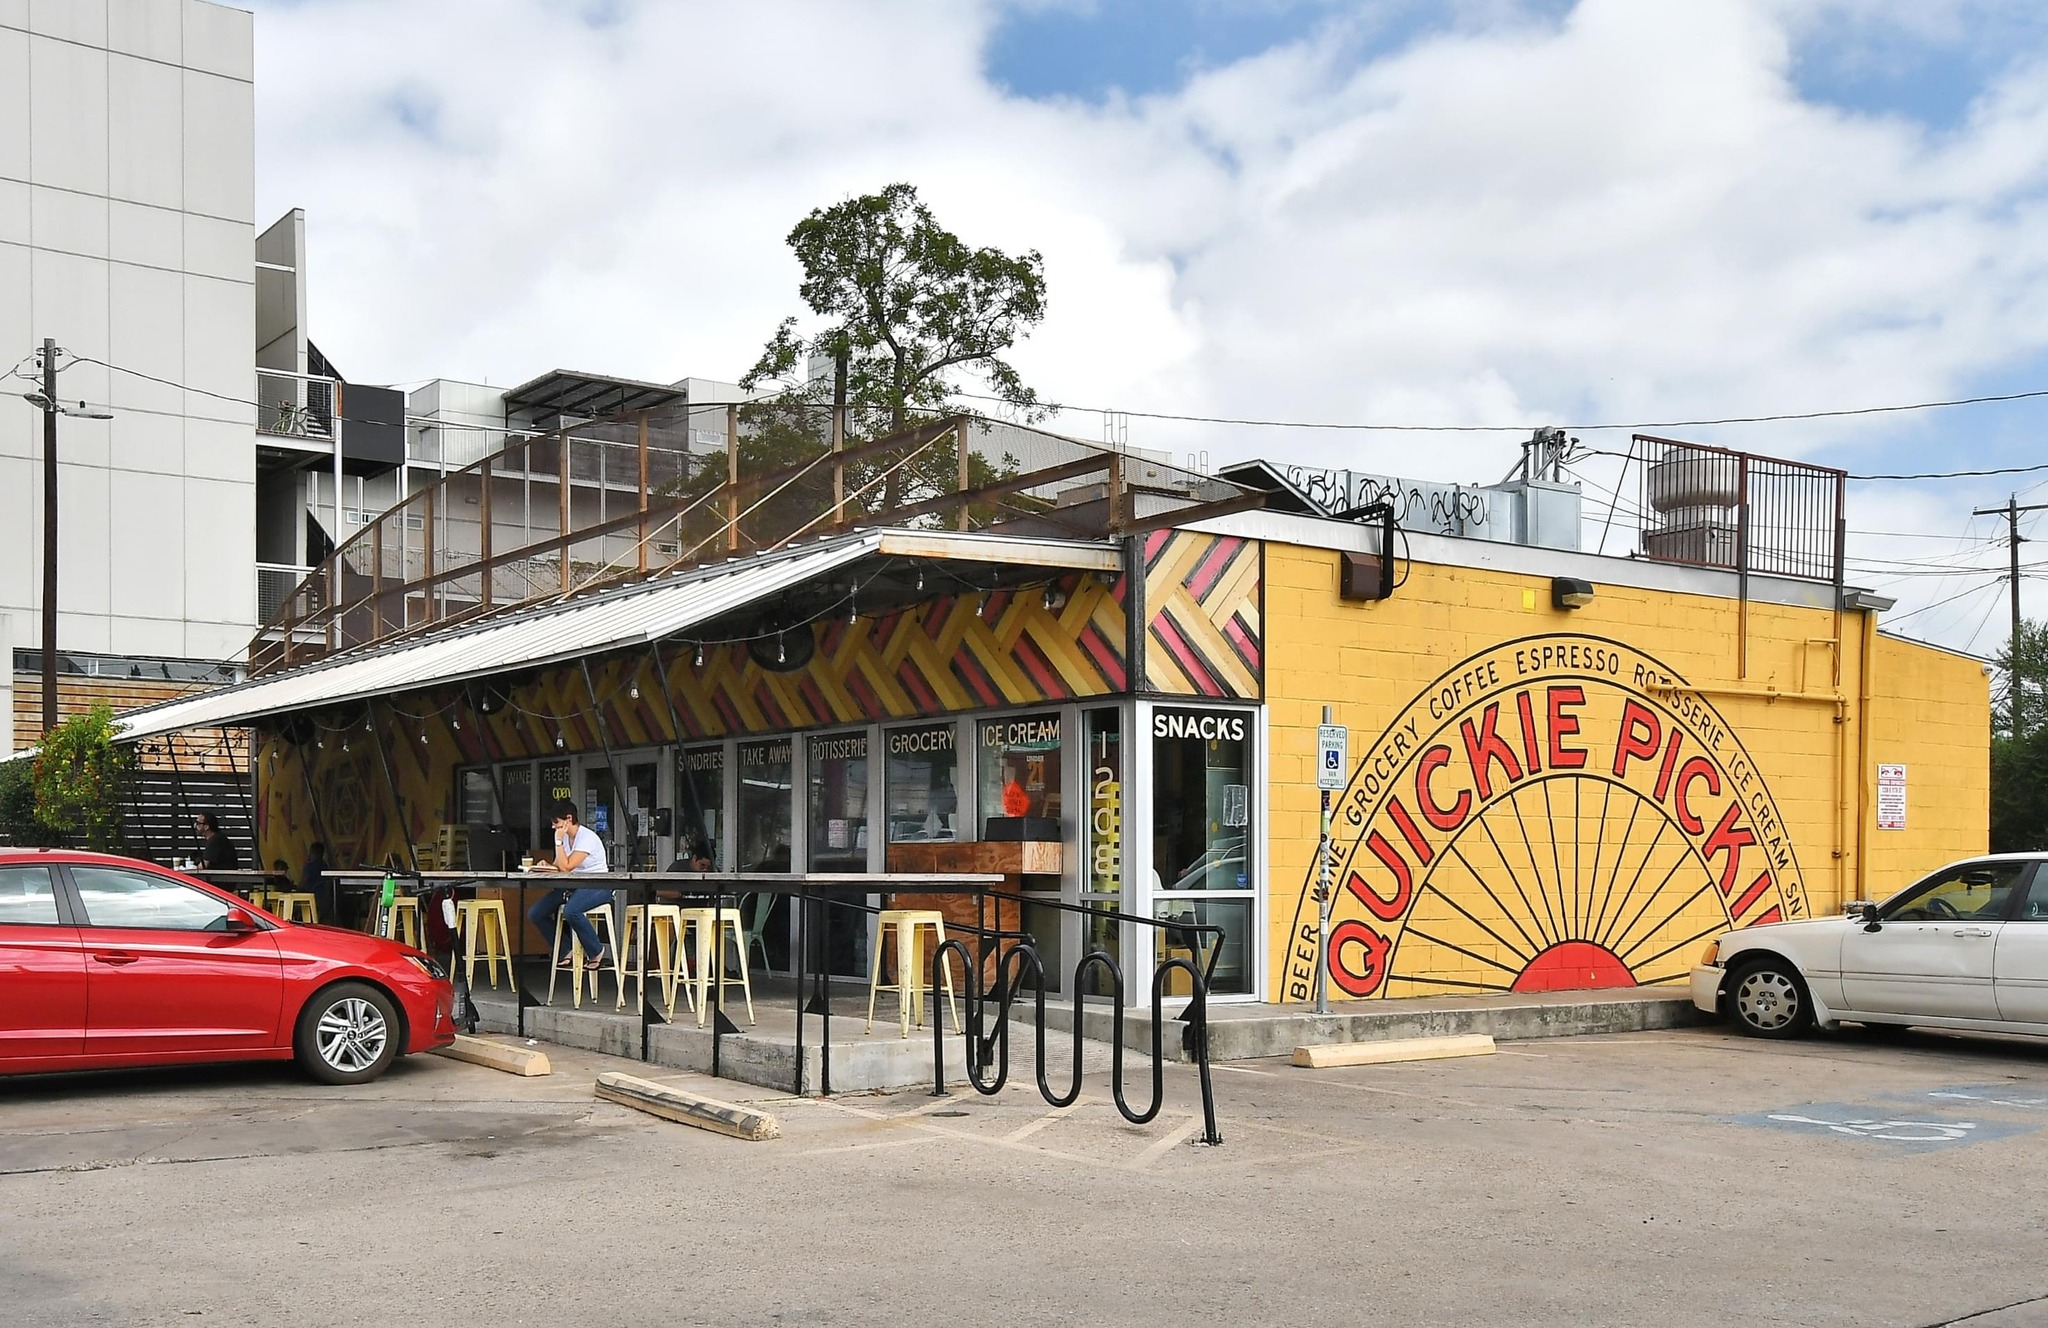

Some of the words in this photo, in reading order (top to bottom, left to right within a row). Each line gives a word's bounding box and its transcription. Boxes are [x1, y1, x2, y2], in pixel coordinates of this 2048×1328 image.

[982, 724, 1004, 747] ICE
[1008, 719, 1061, 744] CREAM
[1153, 714, 1245, 741] SNACKS
[1320, 729, 1345, 739] RESERVED
[812, 738, 867, 761] ROTISSERIE
[890, 730, 956, 754] GROCERY
[1321, 740, 1343, 750] PARKING
[742, 748, 764, 767] TAKE
[768, 745, 792, 764] AWAY
[1290, 924, 1319, 1001] BEER
[1345, 717, 1419, 826] GROCERY
[1431, 660, 1500, 721] COFFEE
[1516, 645, 1620, 676] ESPRESSO
[1728, 750, 1753, 794] ICE
[1751, 792, 1789, 871] CREAM
[1785, 883, 1803, 920] SN
[1327, 685, 1588, 997] QUICKIE
[1612, 697, 1783, 928] PICKI
